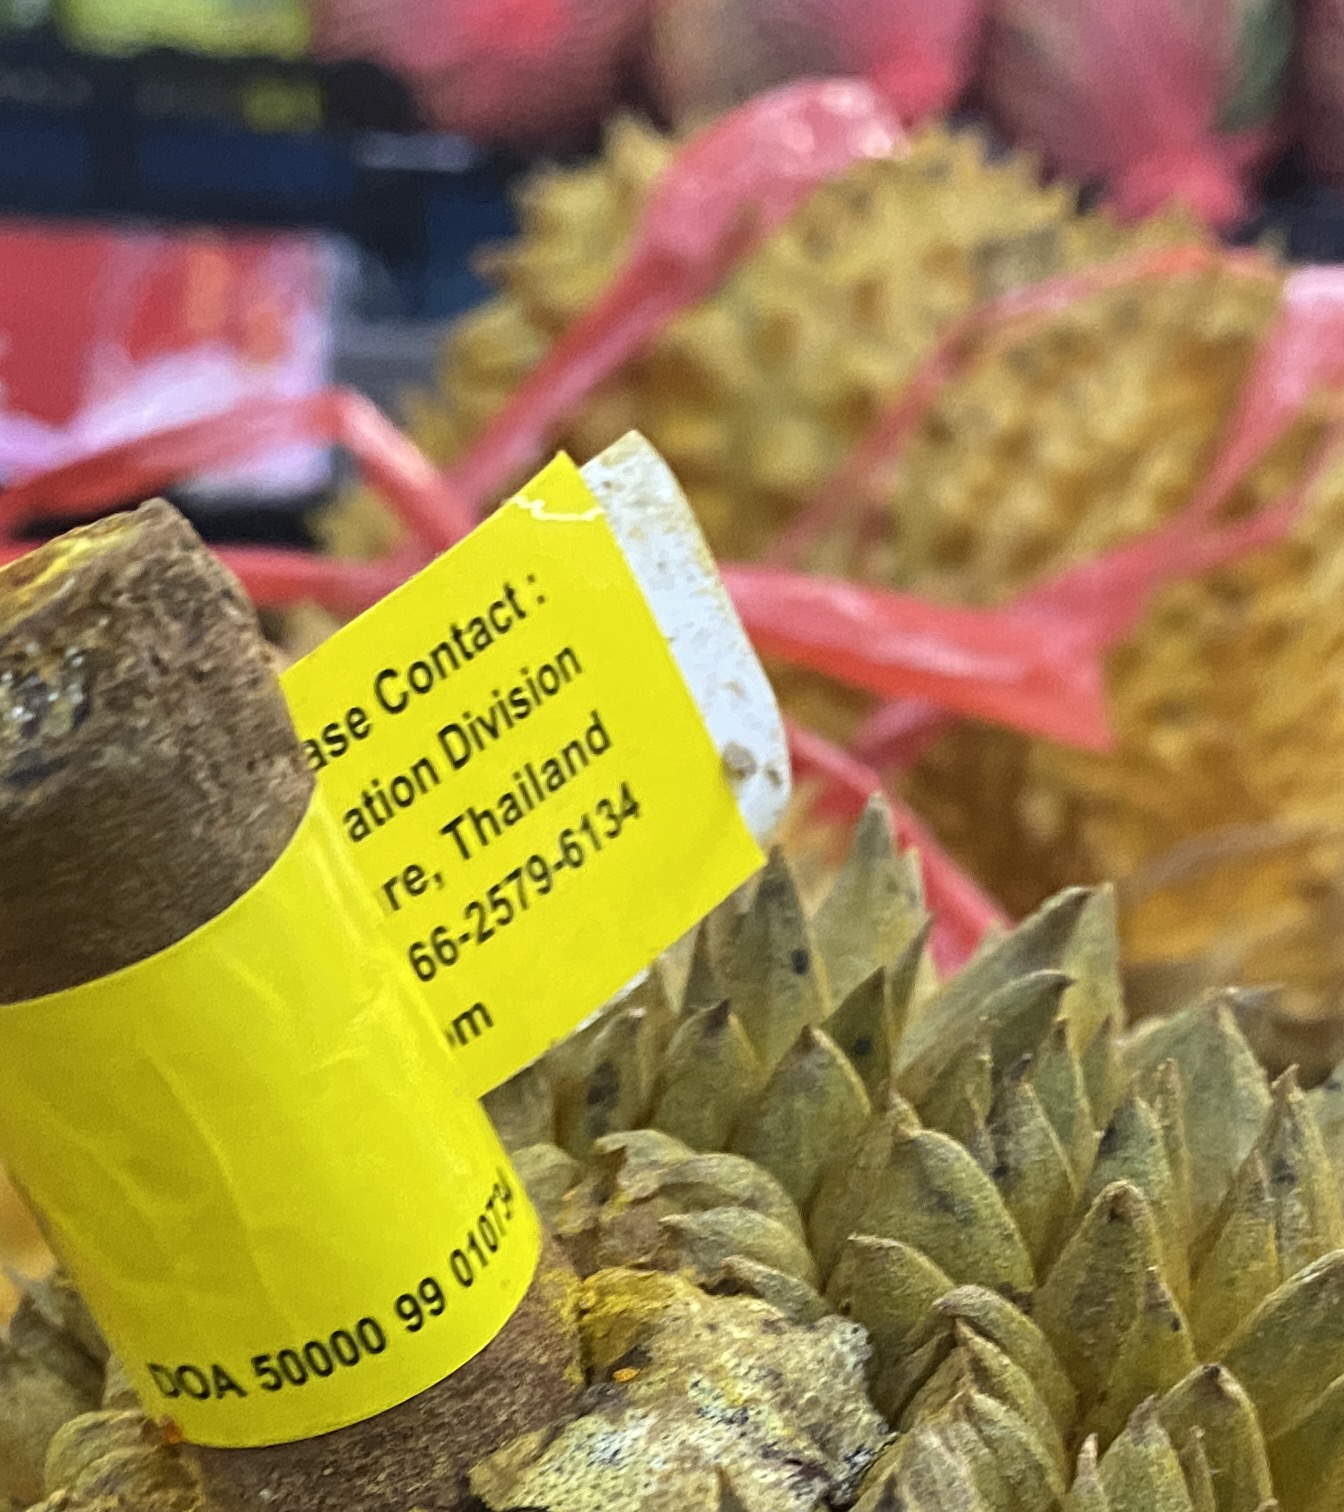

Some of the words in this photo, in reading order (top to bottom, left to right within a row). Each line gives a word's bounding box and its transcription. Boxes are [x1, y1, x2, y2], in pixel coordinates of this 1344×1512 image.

[372, 580, 529, 716] Contact
[342, 756, 443, 843] ation
[436, 645, 584, 772] Division
[438, 709, 613, 861] Thailand
[407, 780, 642, 984] 66-2579-6134
[147, 1361, 249, 1401] DOA
[251, 1316, 388, 1393] 50000
[393, 1276, 447, 1334] 99
